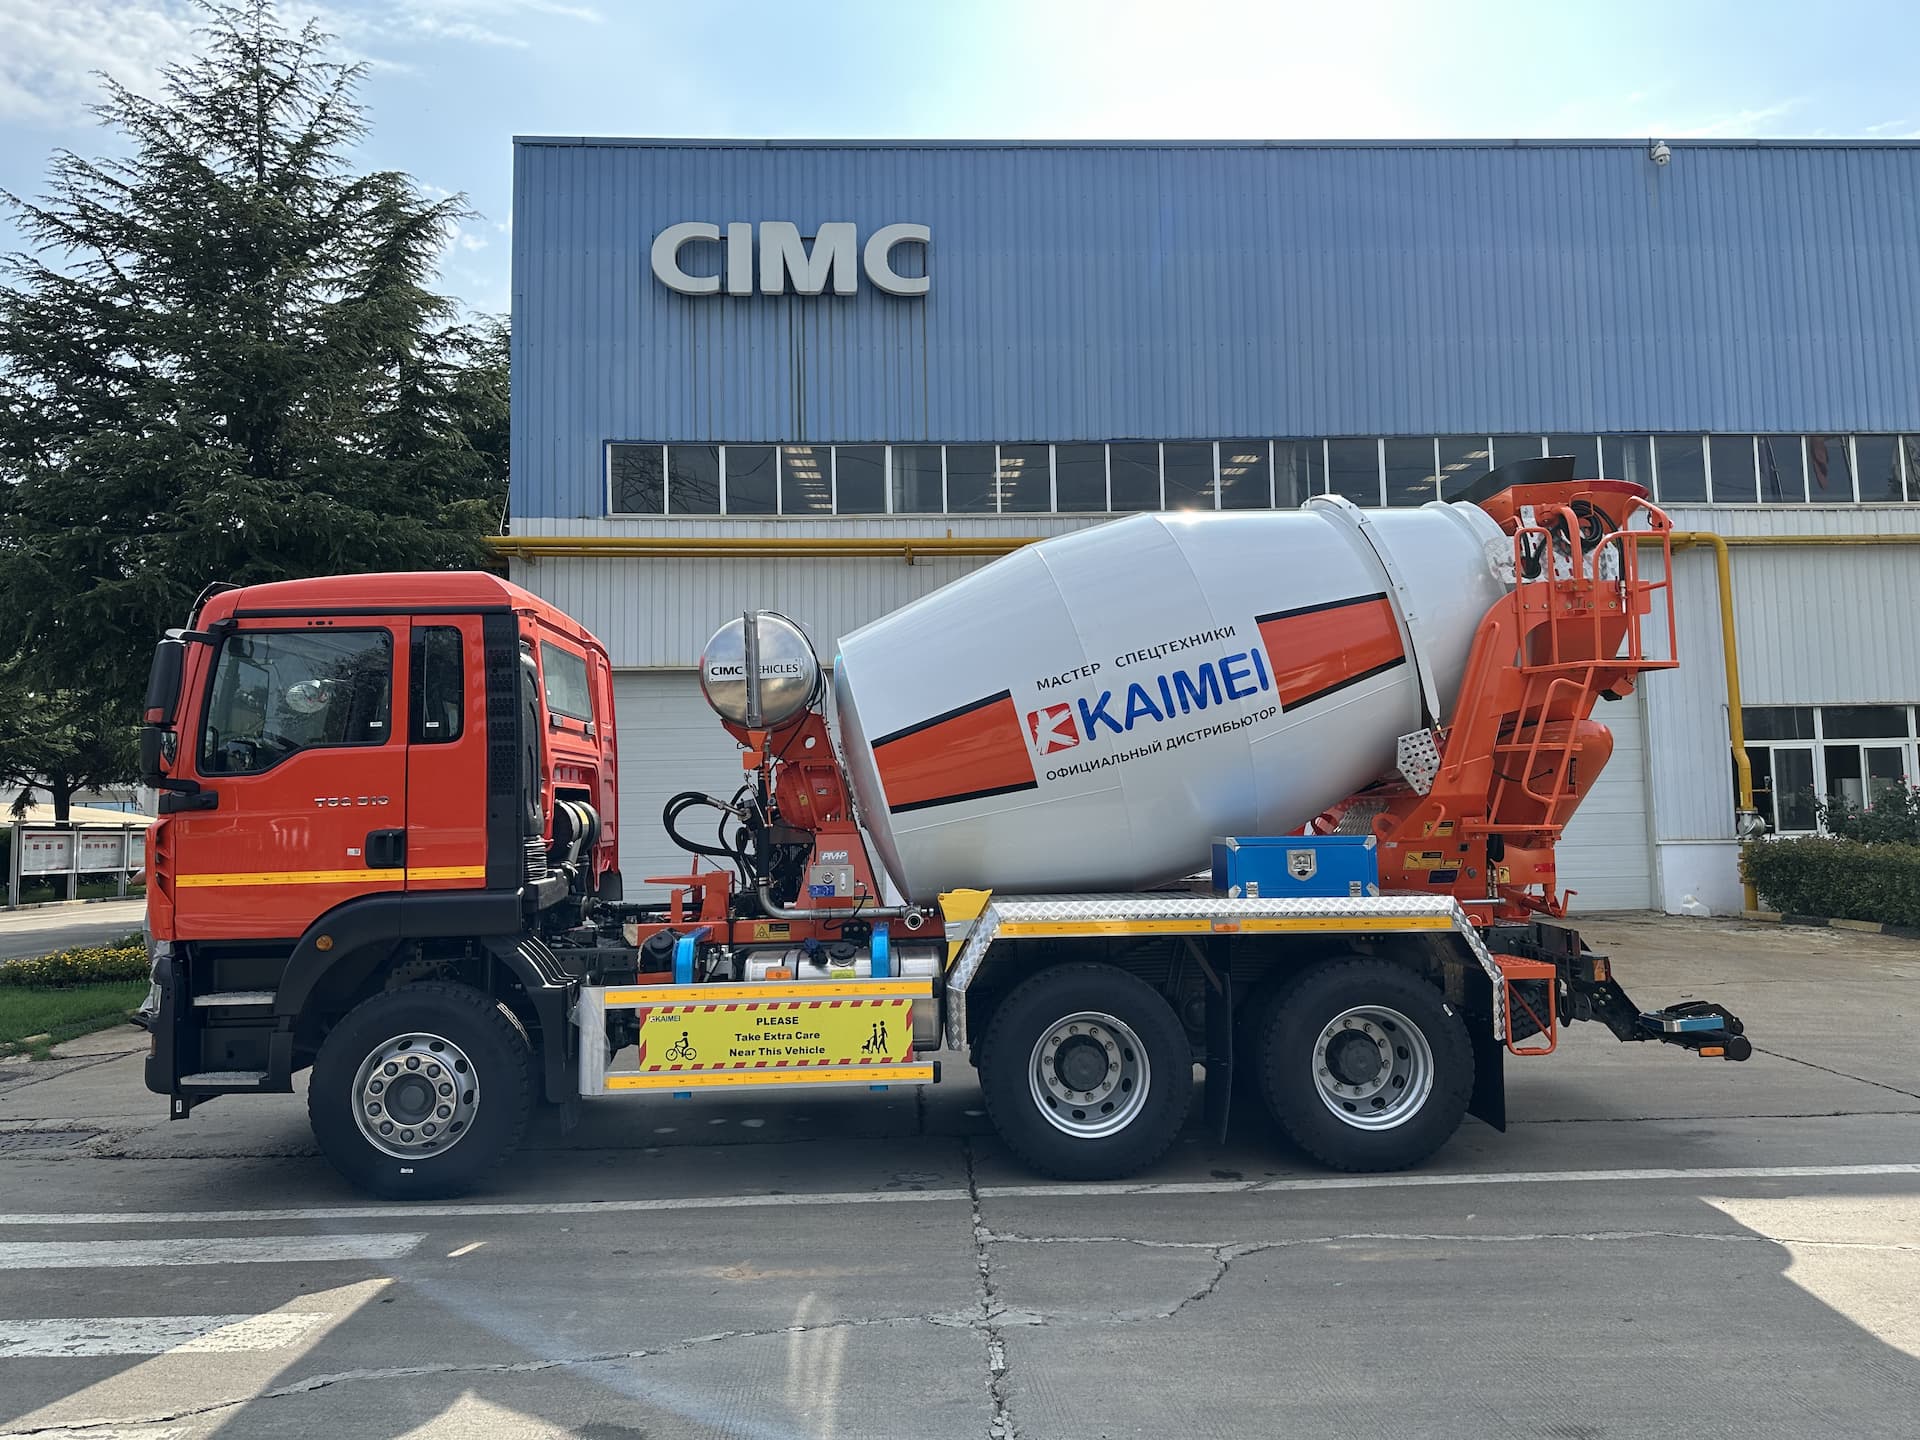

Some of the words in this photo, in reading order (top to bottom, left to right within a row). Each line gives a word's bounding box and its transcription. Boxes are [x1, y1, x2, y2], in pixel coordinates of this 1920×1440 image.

[651, 221, 931, 297] CIMC
[711, 666, 743, 676] CIMC
[758, 663, 799, 675] HICLES
[1036, 662, 1101, 691] МАСТЕР
[1114, 625, 1236, 668] СПЕЦТЕХНИКИ
[1077, 647, 1269, 741] KAIMEI
[1046, 739, 1163, 781] ОФИЦИАЛЬНЫЙ
[1166, 706, 1277, 751] ДИСТРИБЬЮТОР
[735, 1033, 761, 1042] Take
[763, 1032, 793, 1041] Extra
[795, 1031, 821, 1040] Care
[756, 1016, 799, 1026] PLEASE
[729, 1048, 756, 1057] Near
[758, 1047, 782, 1056] This
[784, 1045, 825, 1055] Vehicle
